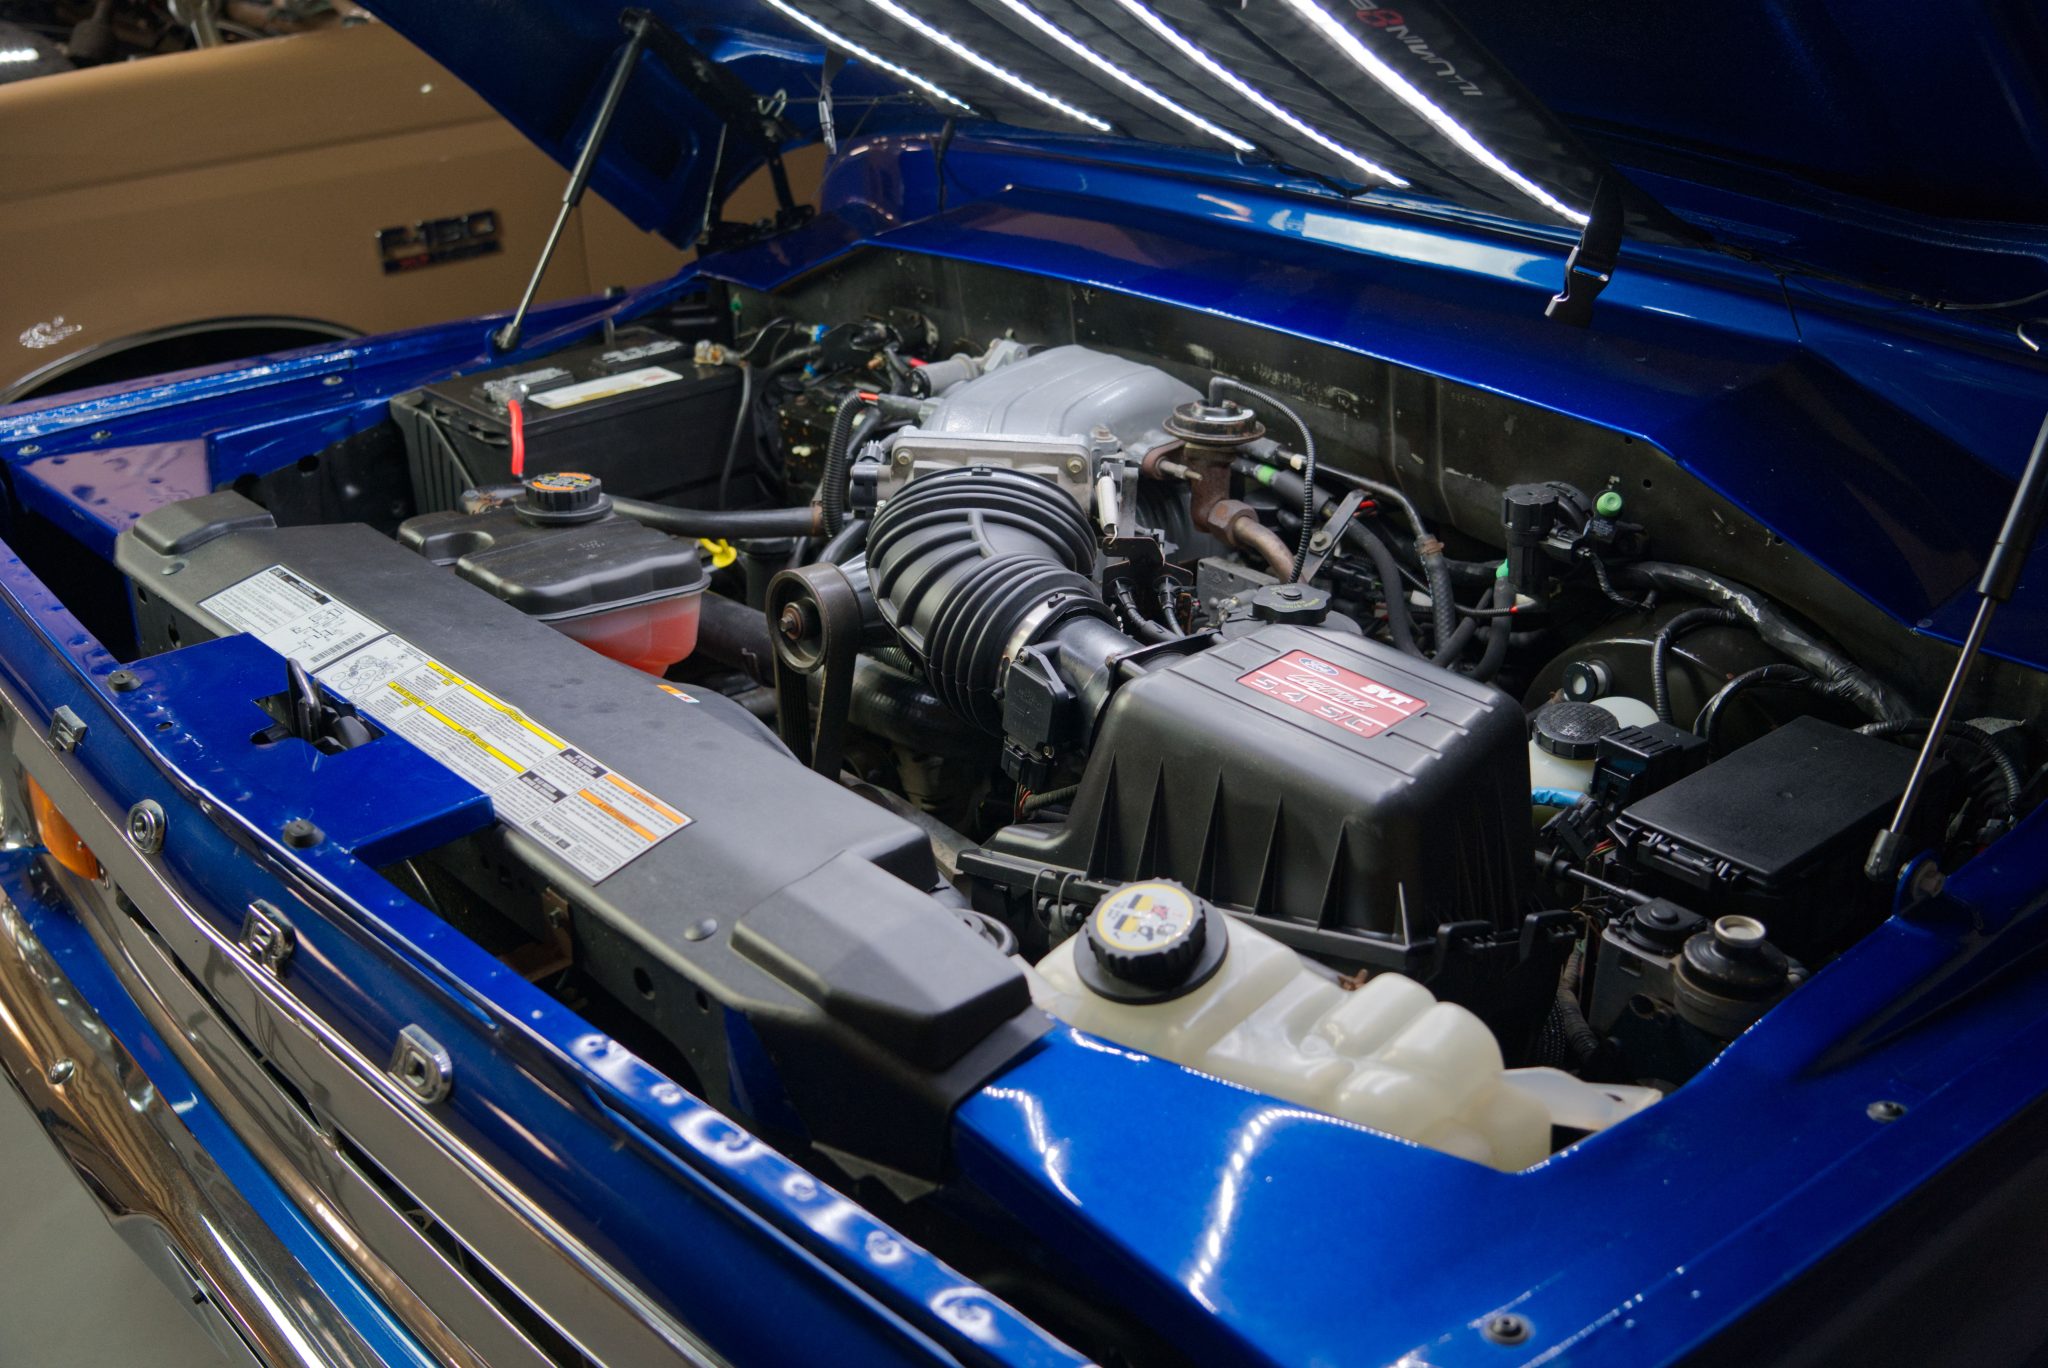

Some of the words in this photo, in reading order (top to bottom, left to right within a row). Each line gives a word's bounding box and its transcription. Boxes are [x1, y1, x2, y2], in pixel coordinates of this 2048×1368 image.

[1251, 675, 1307, 703] 5.4
[1314, 705, 1374, 733] S/C
[1360, 684, 1414, 706] SVT
